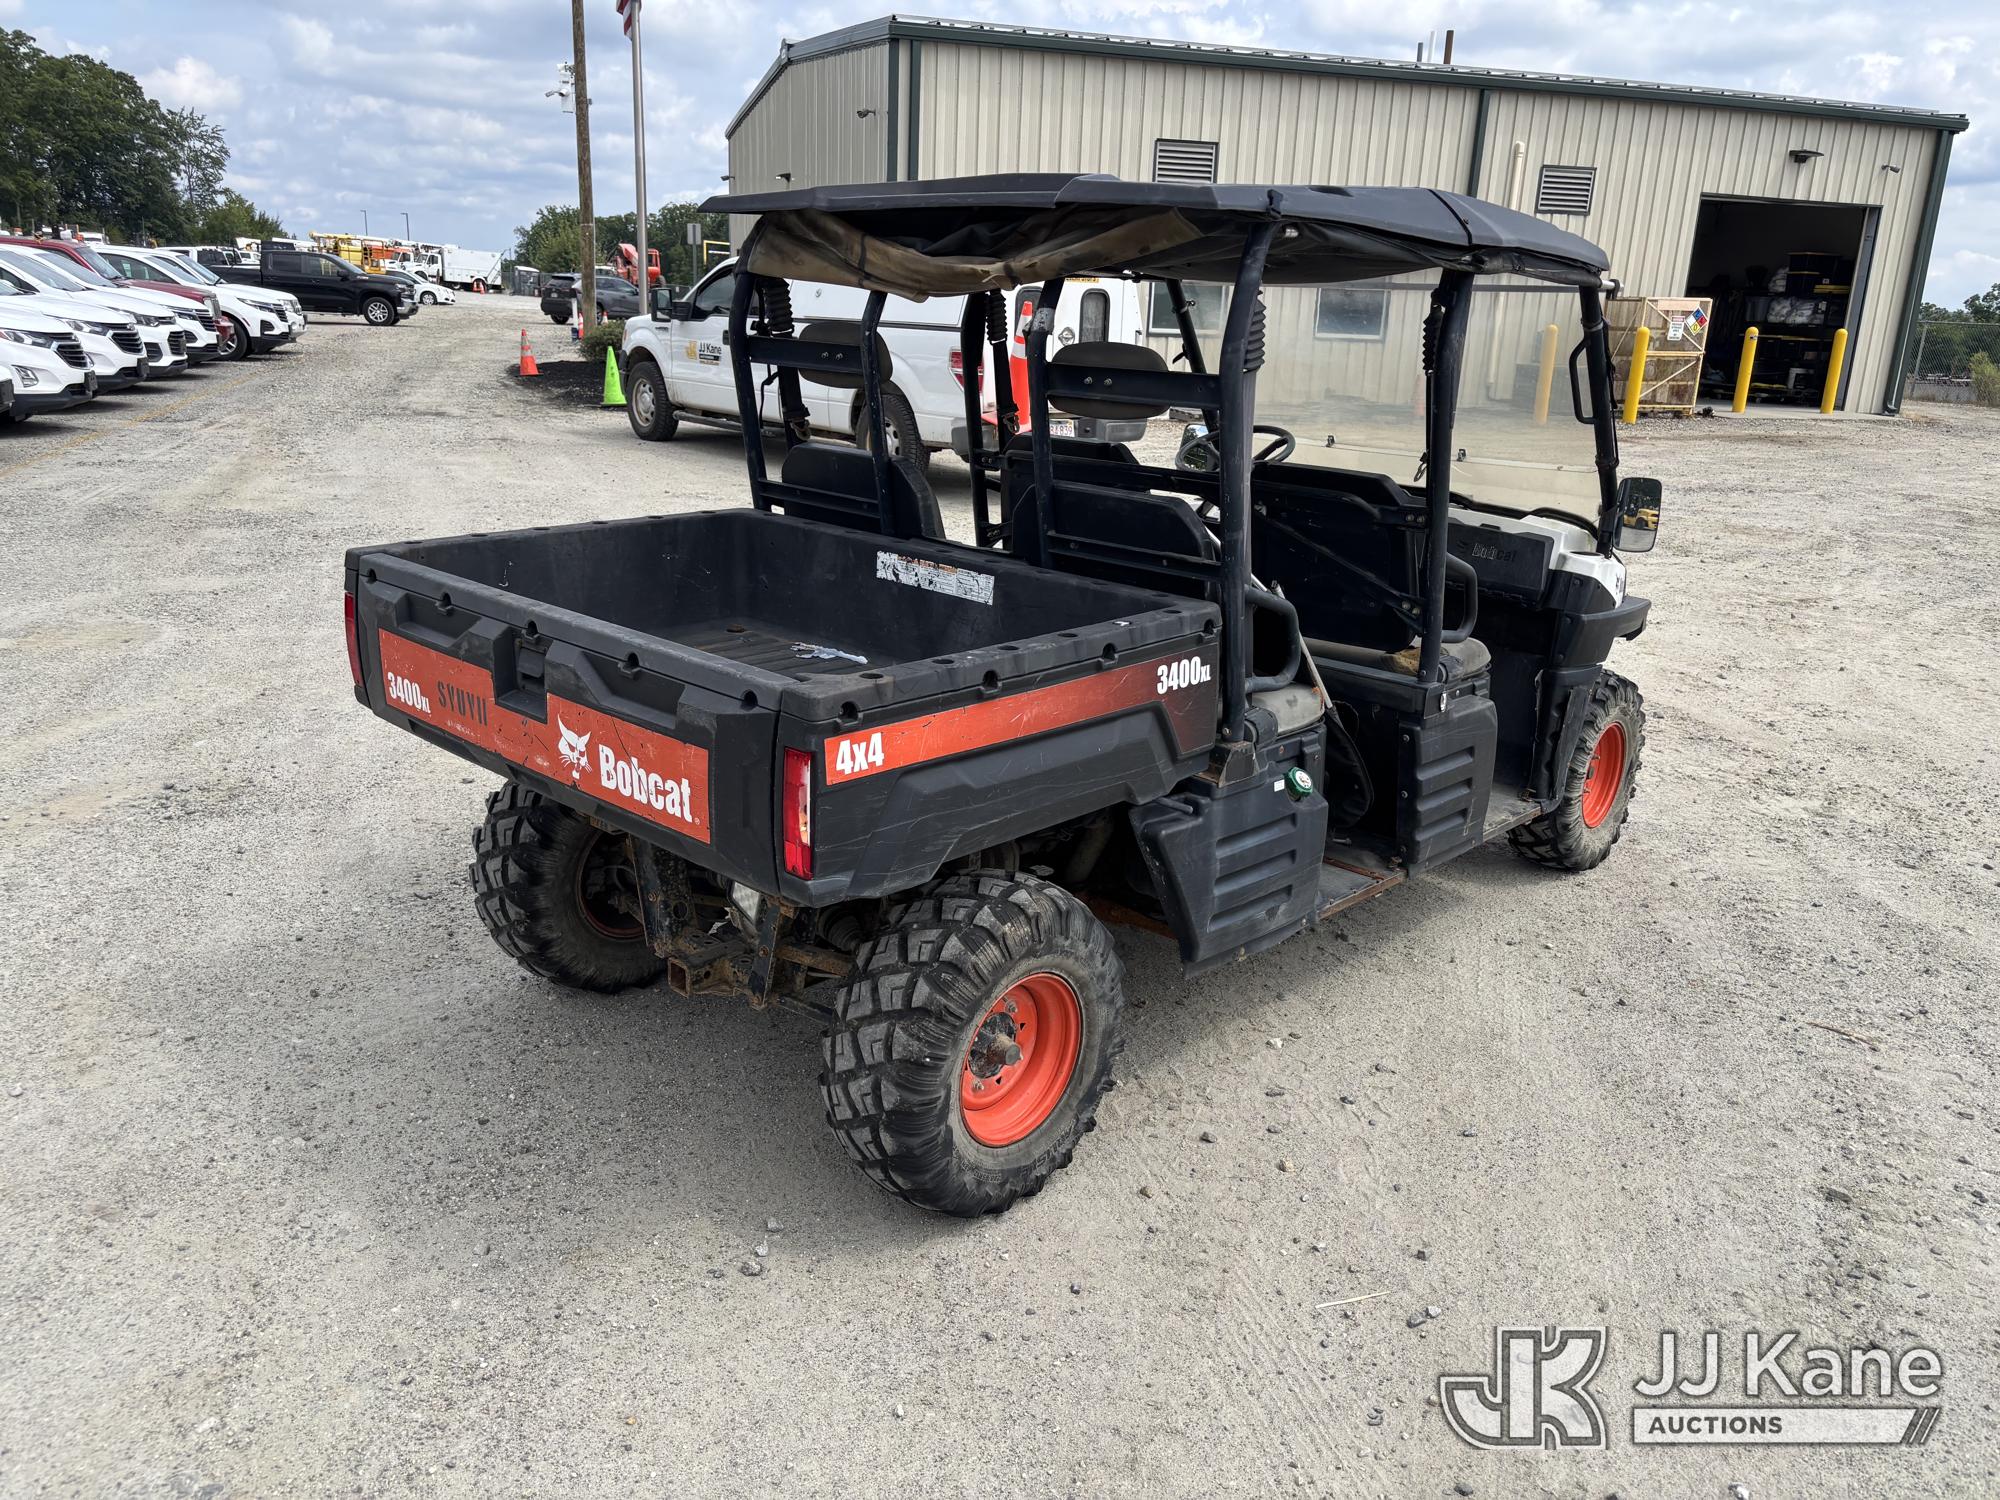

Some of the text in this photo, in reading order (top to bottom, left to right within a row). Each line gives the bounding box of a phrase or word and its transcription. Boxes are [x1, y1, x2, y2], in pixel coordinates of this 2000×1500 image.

[387, 671, 432, 714] 3400XL
[1156, 655, 1212, 695] 3400XL
[836, 731, 885, 775] 4x4
[599, 743, 693, 823] Bobcat
